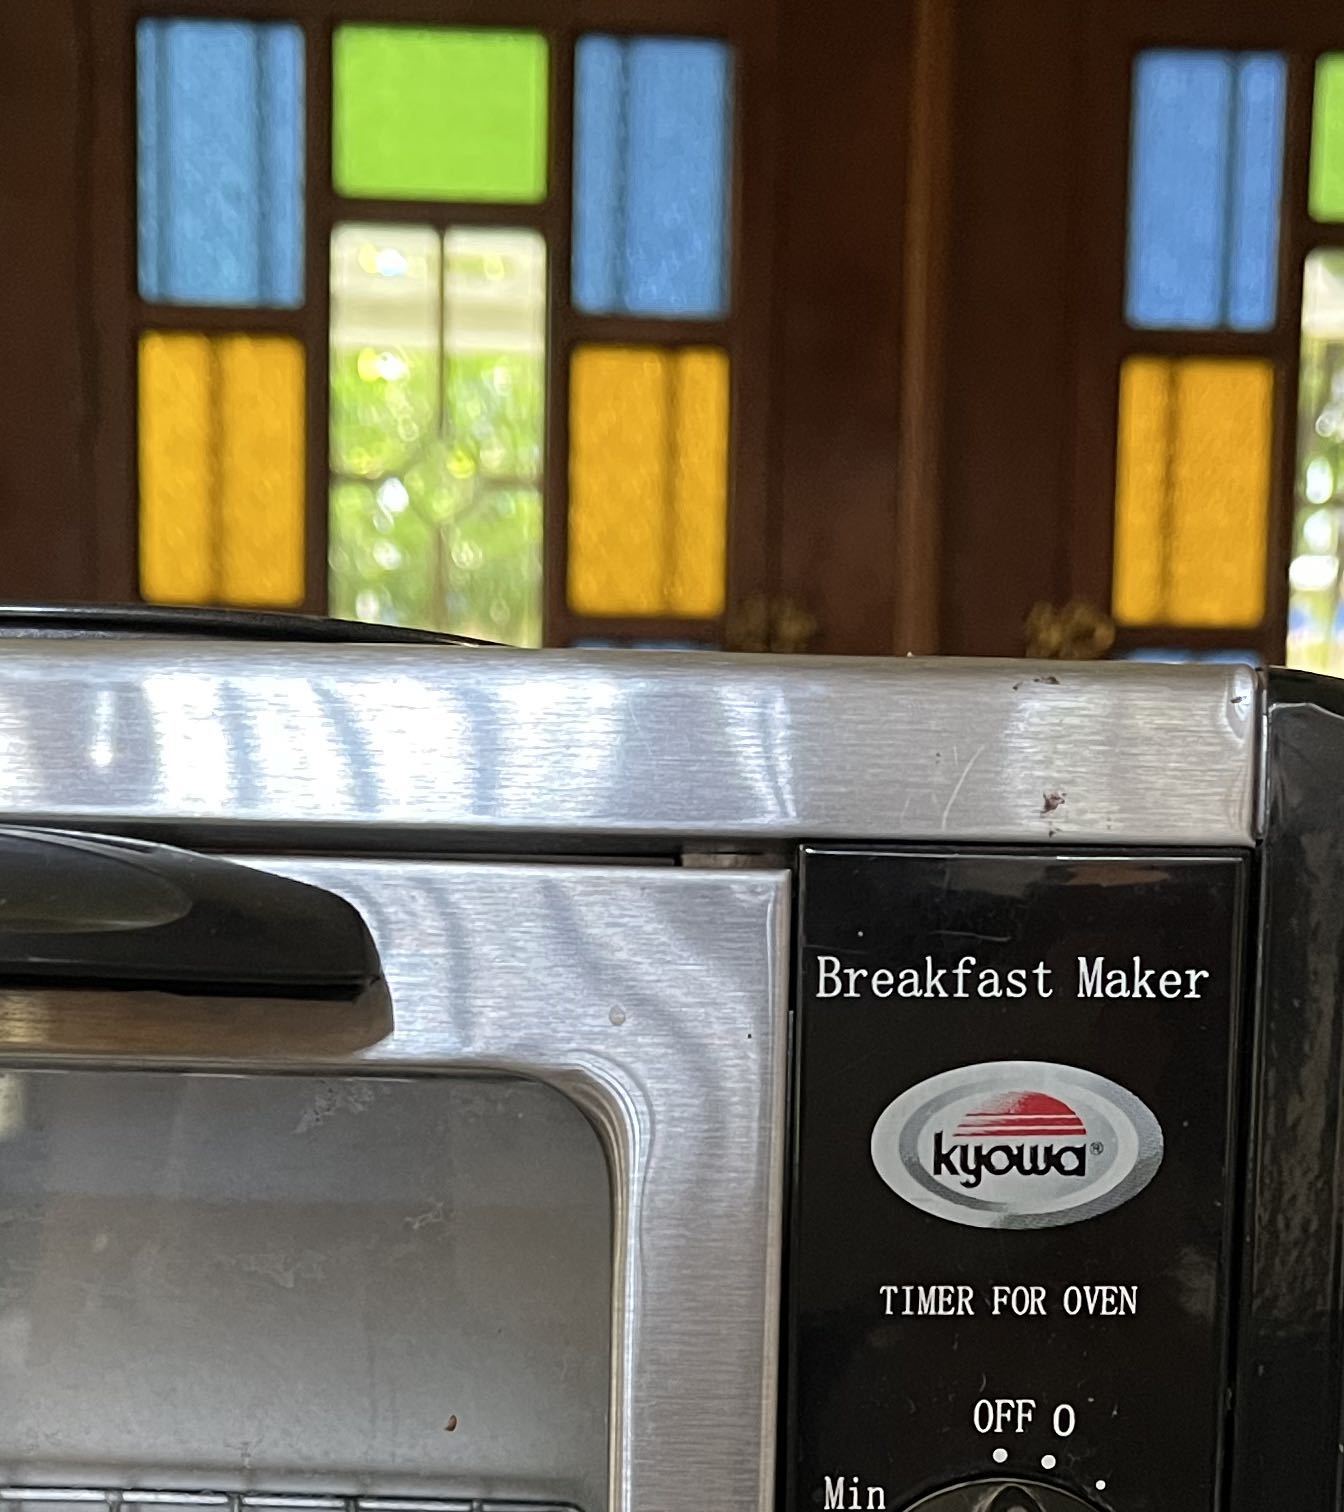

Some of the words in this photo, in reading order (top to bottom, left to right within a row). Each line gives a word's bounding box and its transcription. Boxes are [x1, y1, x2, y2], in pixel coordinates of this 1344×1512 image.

[816, 956, 1052, 998] Breakfast
[1078, 956, 1209, 999] Maker
[934, 1130, 1086, 1188] kyowa
[880, 1286, 975, 1316] TIMER
[992, 1286, 1047, 1316] FOR
[1064, 1286, 1138, 1316] OVEN
[973, 1399, 1037, 1434] OFF
[823, 1475, 886, 1509] Min
